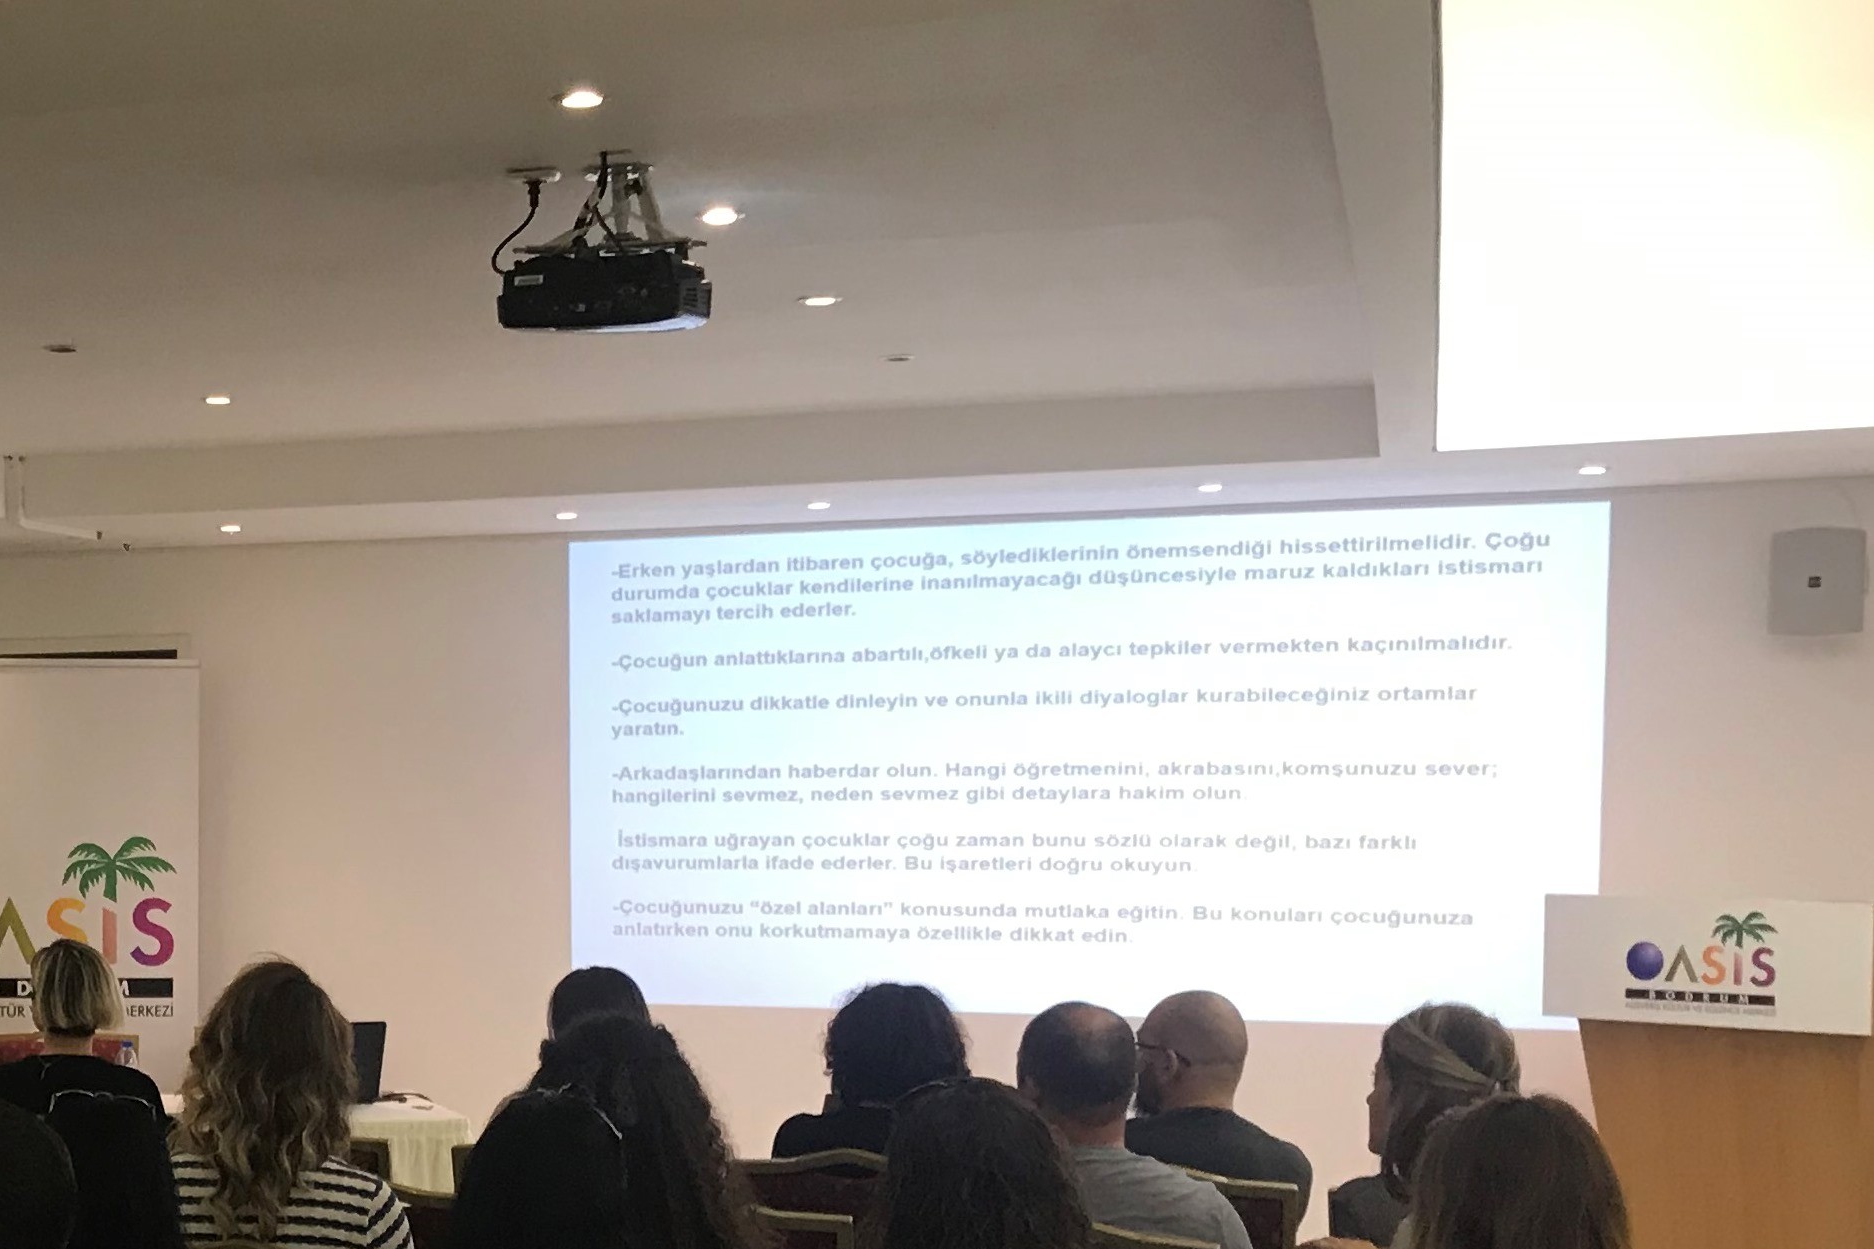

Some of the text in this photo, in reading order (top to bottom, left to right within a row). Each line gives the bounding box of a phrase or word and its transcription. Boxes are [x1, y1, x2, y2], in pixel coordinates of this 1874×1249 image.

[680, 558, 781, 580] yaşlardan
[786, 556, 865, 572] itibaren
[869, 552, 955, 571] çocuğa,
[960, 545, 1120, 568] söylediklerinin
[1125, 540, 1272, 559] önemsendiği
[1279, 535, 1477, 555] hissettirilmelidir.
[1484, 532, 1551, 551] Çoğu
[610, 559, 1543, 603] durumda çocuklar kendilerine inanılmayacağı düşüncesiyle maruz kaldıkları istismarı
[611, 603, 857, 626] saklamayı tercih ederler.
[713, 651, 846, 667] anlattıklarına
[993, 647, 1019, 663] ya
[1024, 643, 1052, 658] da
[1058, 643, 1122, 661] alaycı
[1128, 641, 1212, 660] tepkiler
[1219, 640, 1340, 655] vermekten
[749, 695, 831, 711] dikkatle
[834, 694, 918, 712] dinleyin
[924, 696, 949, 707] ve
[954, 691, 1029, 707] onunla
[1035, 690, 1073, 705] ikili
[1079, 689, 1189, 708] diyaloglar
[1196, 688, 1370, 707] kurabileceğiniz
[1376, 687, 1478, 702] ortamlar
[611, 722, 685, 740] yaratın.
[787, 765, 881, 780] haberdar
[886, 763, 939, 777] olun.
[945, 764, 1007, 782] Hangi
[1012, 762, 1150, 780] öğretmenini,
[611, 788, 717, 808] hangilerini
[721, 790, 805, 804] sevmez,
[810, 788, 874, 802] neden
[879, 790, 960, 802] sevmez
[965, 786, 1005, 804] gibi
[1011, 787, 1111, 805] detaylara
[1118, 786, 1185, 799] hakim
[713, 833, 796, 851] uğrayan
[801, 834, 891, 851] çocuklar
[896, 834, 949, 852] çoğu
[955, 837, 1025, 848] zaman
[1031, 833, 1087, 847] bunu
[1093, 834, 1152, 847] sözlü
[1159, 834, 1227, 848] olarak
[1304, 836, 1351, 850] bazı
[1358, 836, 1417, 850] farklı
[611, 855, 760, 873] dışavurumlarla
[765, 856, 815, 871] ifade
[820, 856, 897, 870] ederler.
[904, 857, 933, 871] Bu
[939, 857, 1032, 874] işaretleri
[1038, 857, 1103, 875] doğru
[900, 903, 1018, 918] konusunda
[1024, 905, 1110, 919] mutlaka
[1192, 906, 1223, 920] Bu
[1230, 908, 1323, 923] konuları
[1330, 910, 1474, 928] çocuğunuza
[611, 921, 1133, 944] anlatırken onu korkutmamaya özellikle dikkat edin.
[1626, 941, 1776, 987] OASIS
